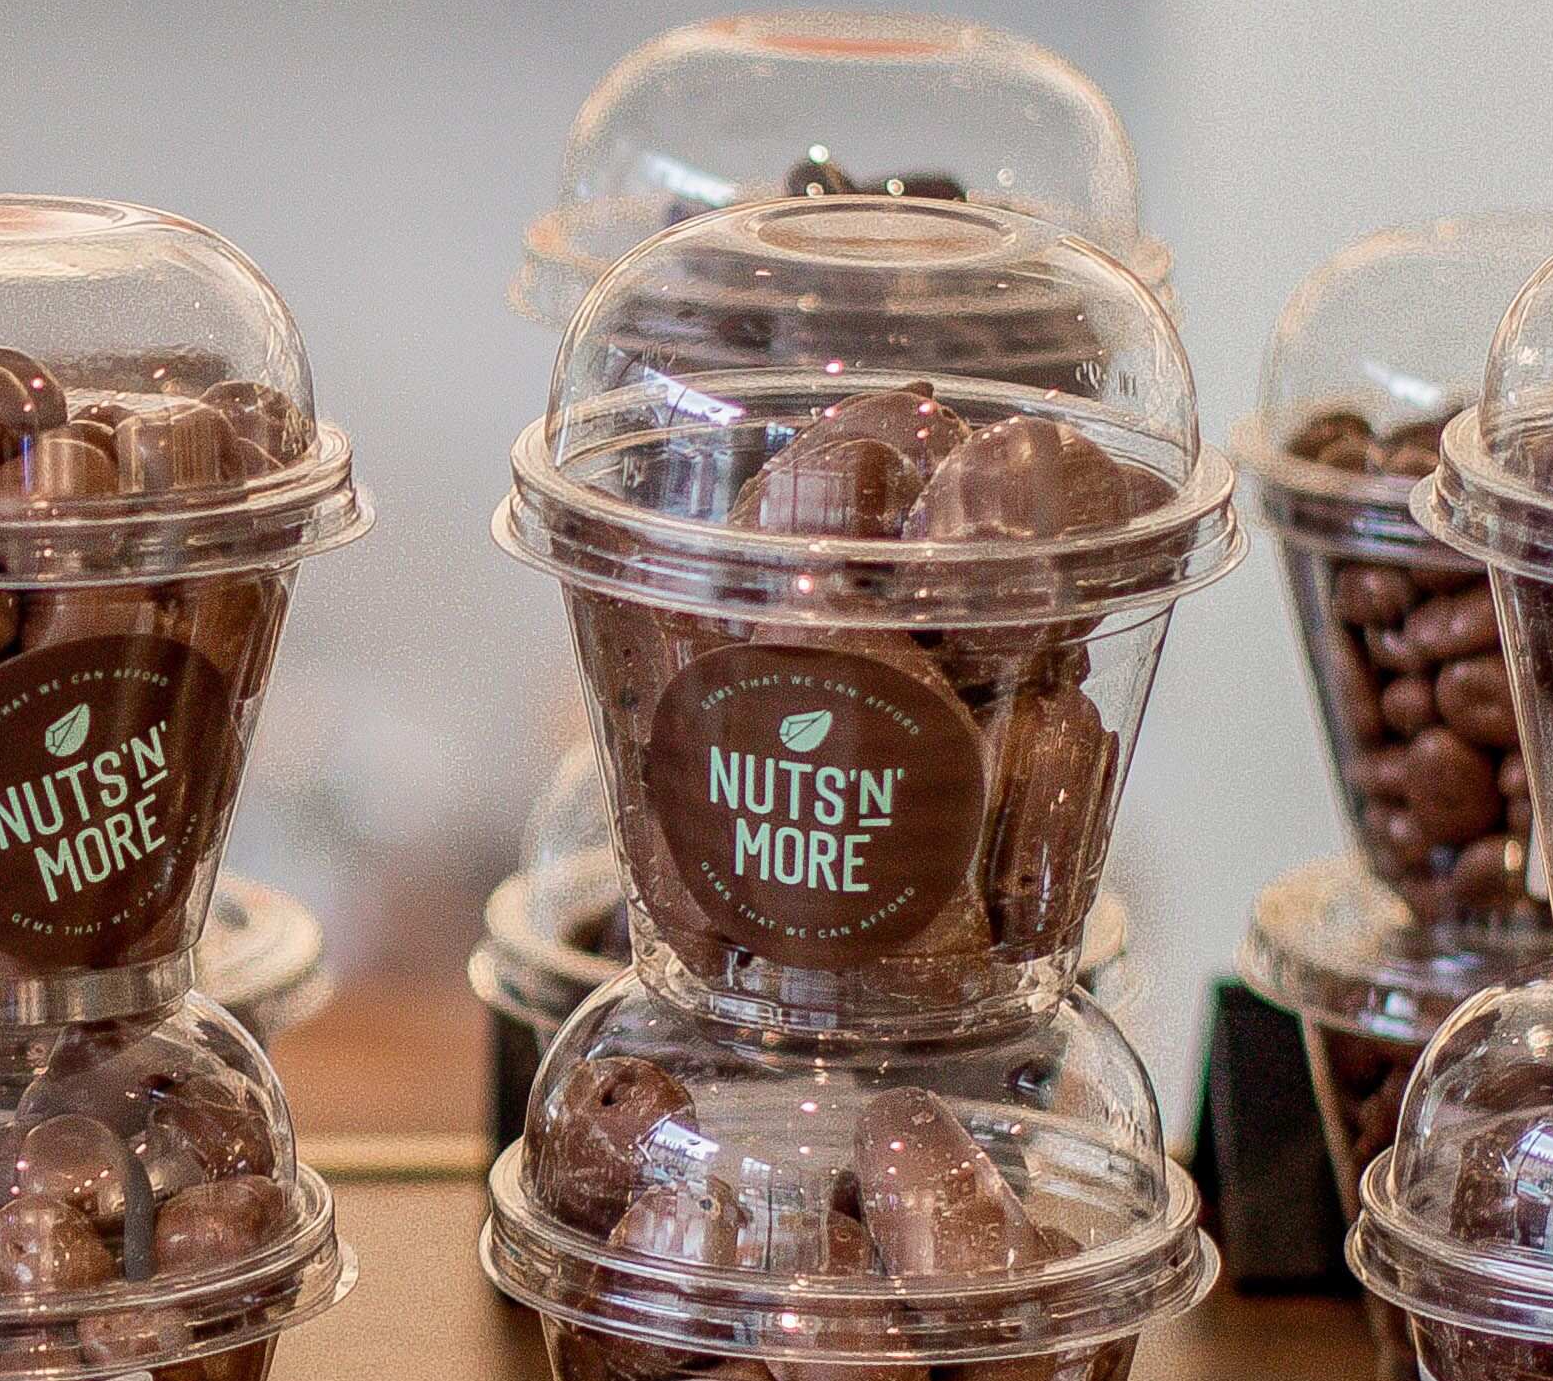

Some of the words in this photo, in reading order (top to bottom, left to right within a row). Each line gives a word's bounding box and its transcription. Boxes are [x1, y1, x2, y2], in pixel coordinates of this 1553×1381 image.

[709, 745, 905, 827] NUTS'N'
[34, 793, 166, 903] MORE
[735, 818, 871, 892] MORE
[64, 921, 102, 936] THAT
